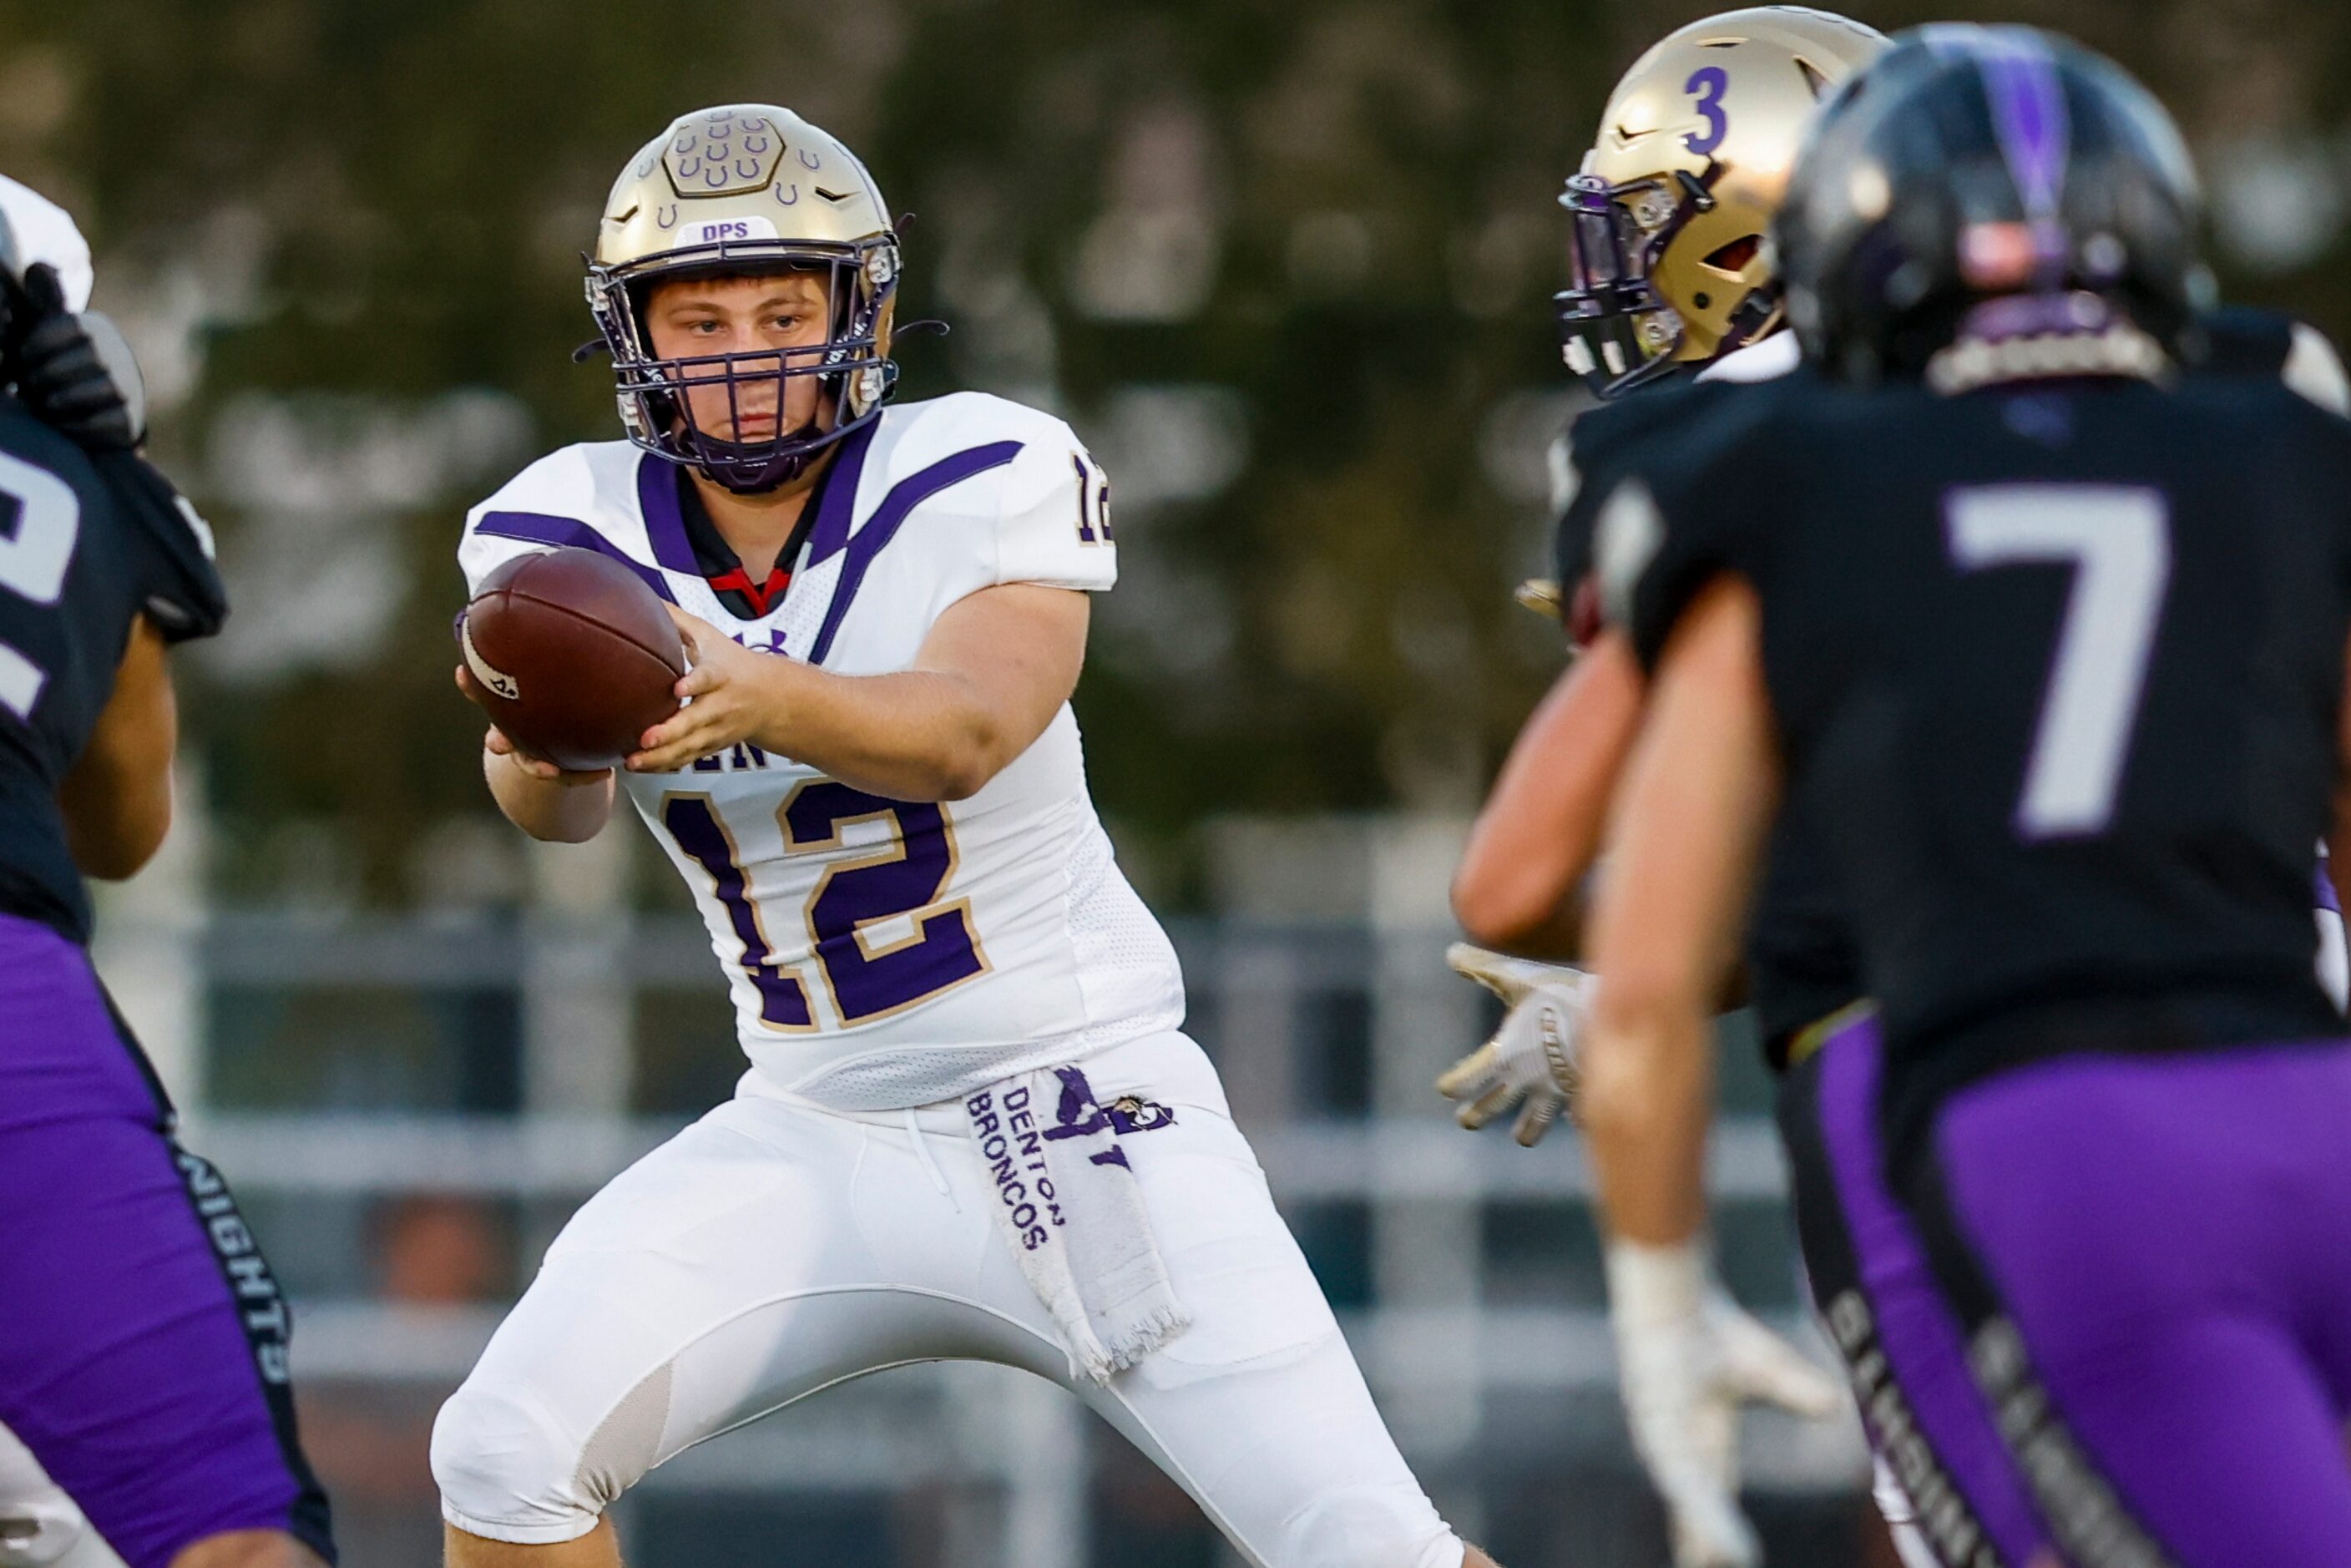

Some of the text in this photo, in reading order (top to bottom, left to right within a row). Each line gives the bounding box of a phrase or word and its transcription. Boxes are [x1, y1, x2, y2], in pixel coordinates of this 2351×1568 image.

[1685, 66, 1728, 154] 3
[703, 222, 748, 241] DPS
[1942, 483, 2171, 840] 7
[658, 776, 993, 1034] 12
[966, 1090, 1049, 1251] BRONCOS
[1003, 1086, 1065, 1226] DENTON
